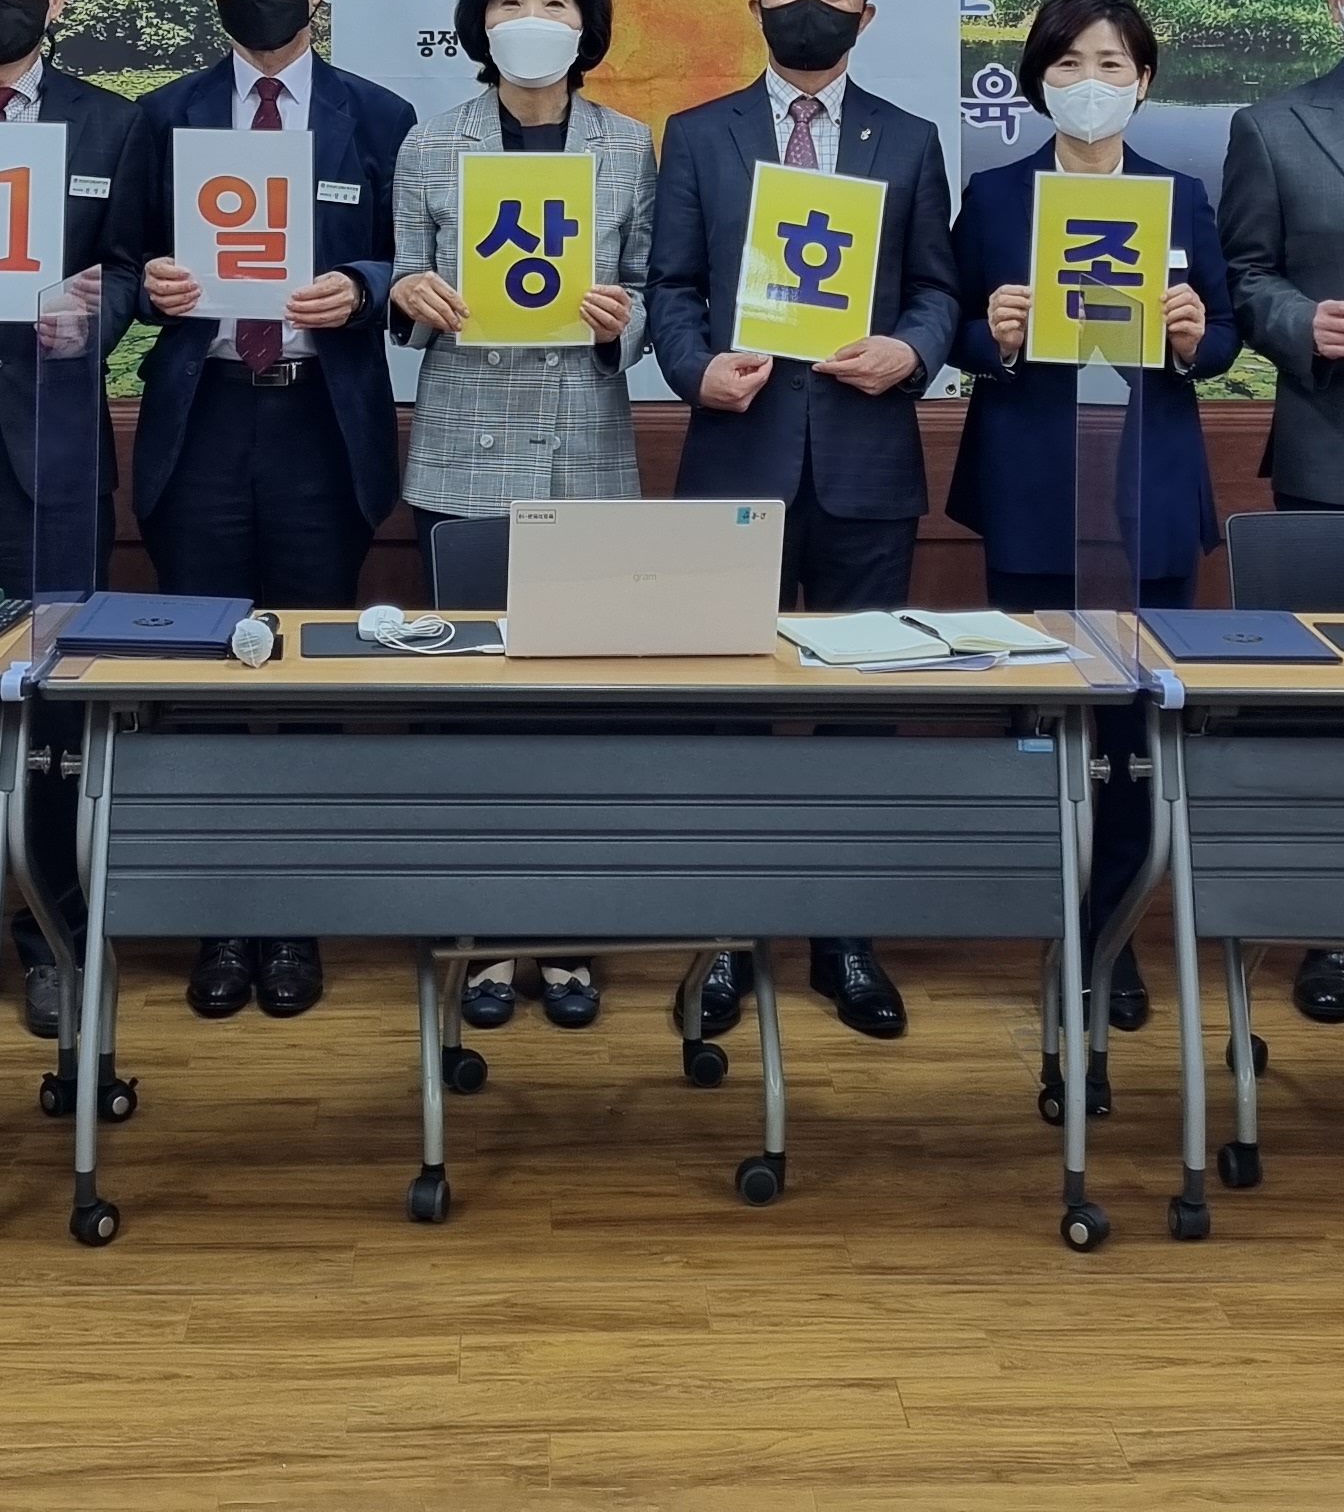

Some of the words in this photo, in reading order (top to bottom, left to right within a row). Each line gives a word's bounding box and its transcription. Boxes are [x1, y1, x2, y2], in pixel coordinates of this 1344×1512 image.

[197, 175, 289, 281] 일
[475, 199, 579, 308] 상
[766, 209, 853, 310] 호
[1057, 218, 1144, 322] 존
[632, 573, 657, 584] gram
